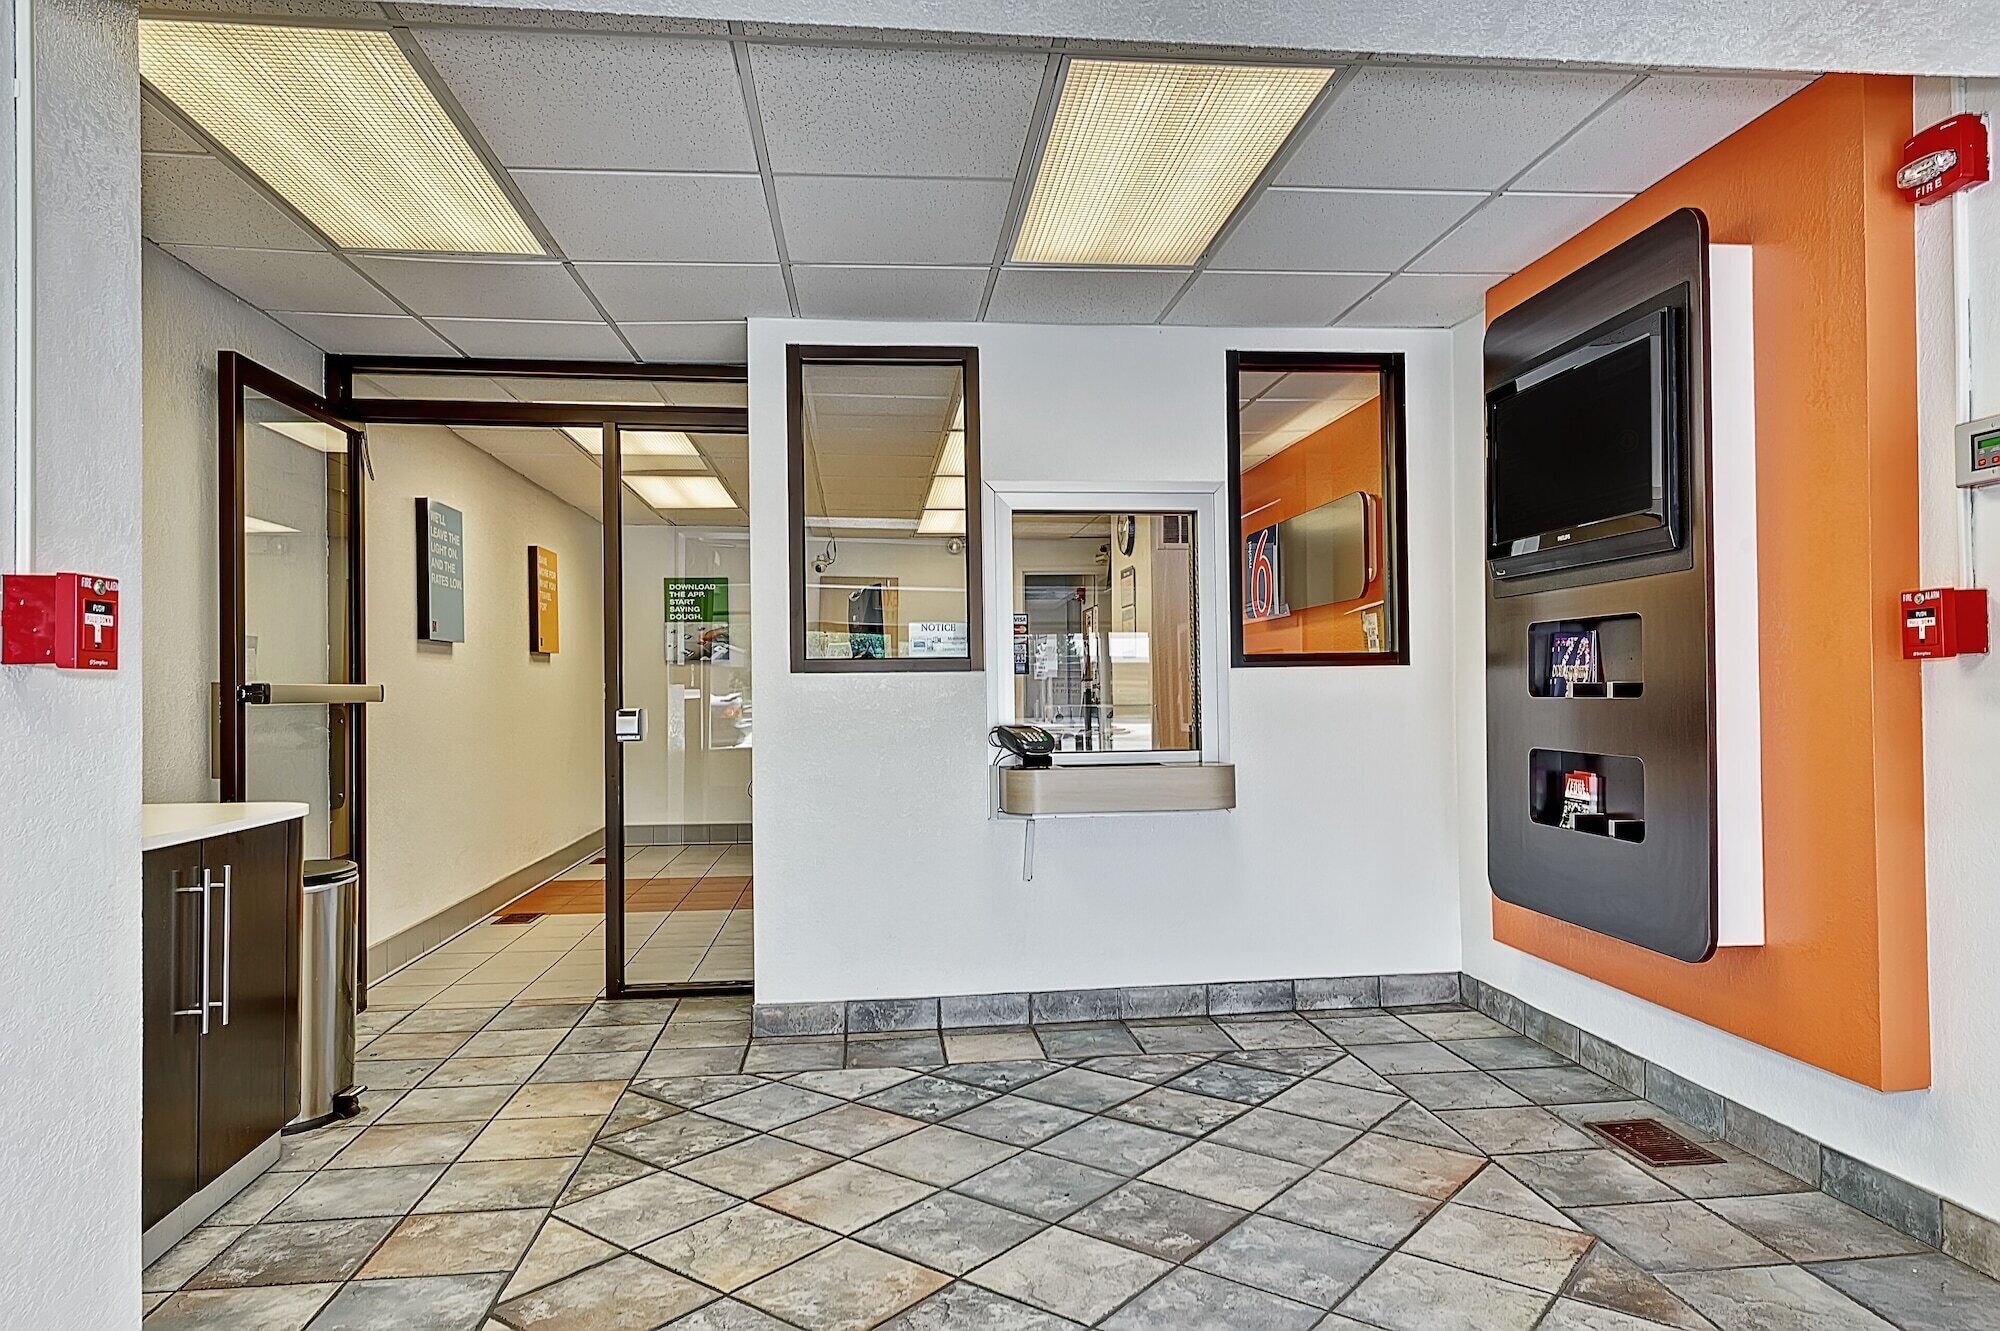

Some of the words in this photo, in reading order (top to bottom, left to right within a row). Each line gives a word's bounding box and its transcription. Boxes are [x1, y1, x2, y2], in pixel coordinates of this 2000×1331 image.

[1915, 178, 1942, 198] FIRE
[430, 511, 446, 526] WE'LL
[430, 525, 448, 542] LEAVE
[448, 533, 460, 546] THE
[431, 542, 447, 555] LIGHT
[431, 558, 444, 570] AND
[444, 561, 456, 574] THE
[1251, 529, 1273, 618] 6
[431, 573, 449, 587] RATES
[1902, 593, 1912, 602] FIRE
[1925, 591, 1940, 600] ALARM
[921, 623, 956, 631] NOTICE
